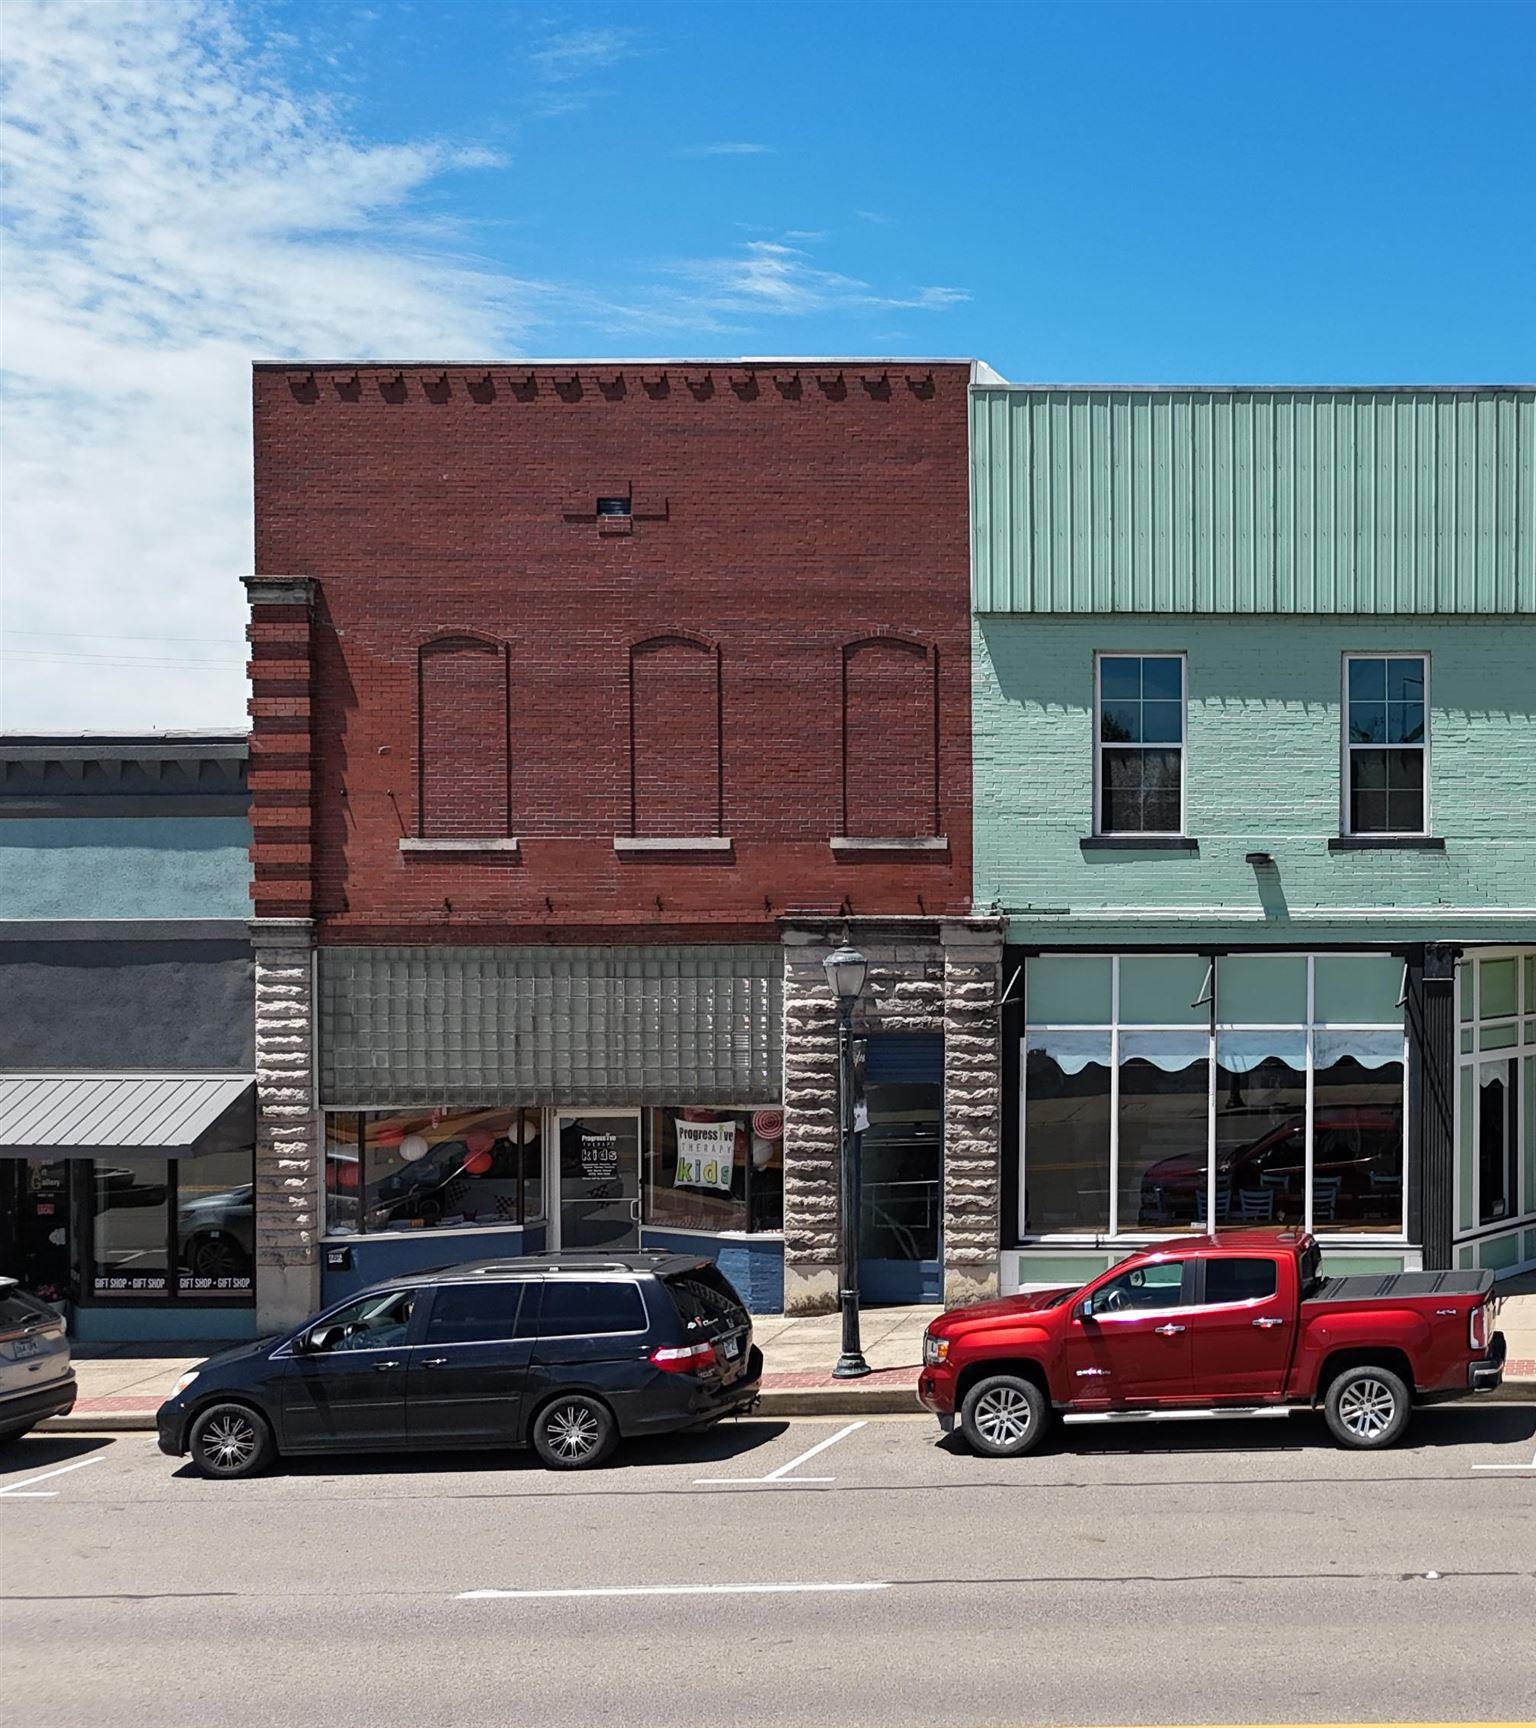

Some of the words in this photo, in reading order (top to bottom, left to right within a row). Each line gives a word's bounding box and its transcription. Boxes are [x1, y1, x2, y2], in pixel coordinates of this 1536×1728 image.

[679, 1125, 734, 1141] Progressive
[682, 1142, 731, 1154] THERAPY
[581, 1149, 618, 1161] kids
[677, 1157, 730, 1184] kids
[94, 1278, 109, 1288] GIFT
[109, 1278, 127, 1288] SHOP
[132, 1278, 147, 1288] GIFT
[147, 1278, 165, 1288] SHOP
[179, 1278, 194, 1288] GIFT
[194, 1278, 212, 1288] SHOP
[217, 1278, 232, 1288] GIFT
[233, 1278, 250, 1288] SHOP
